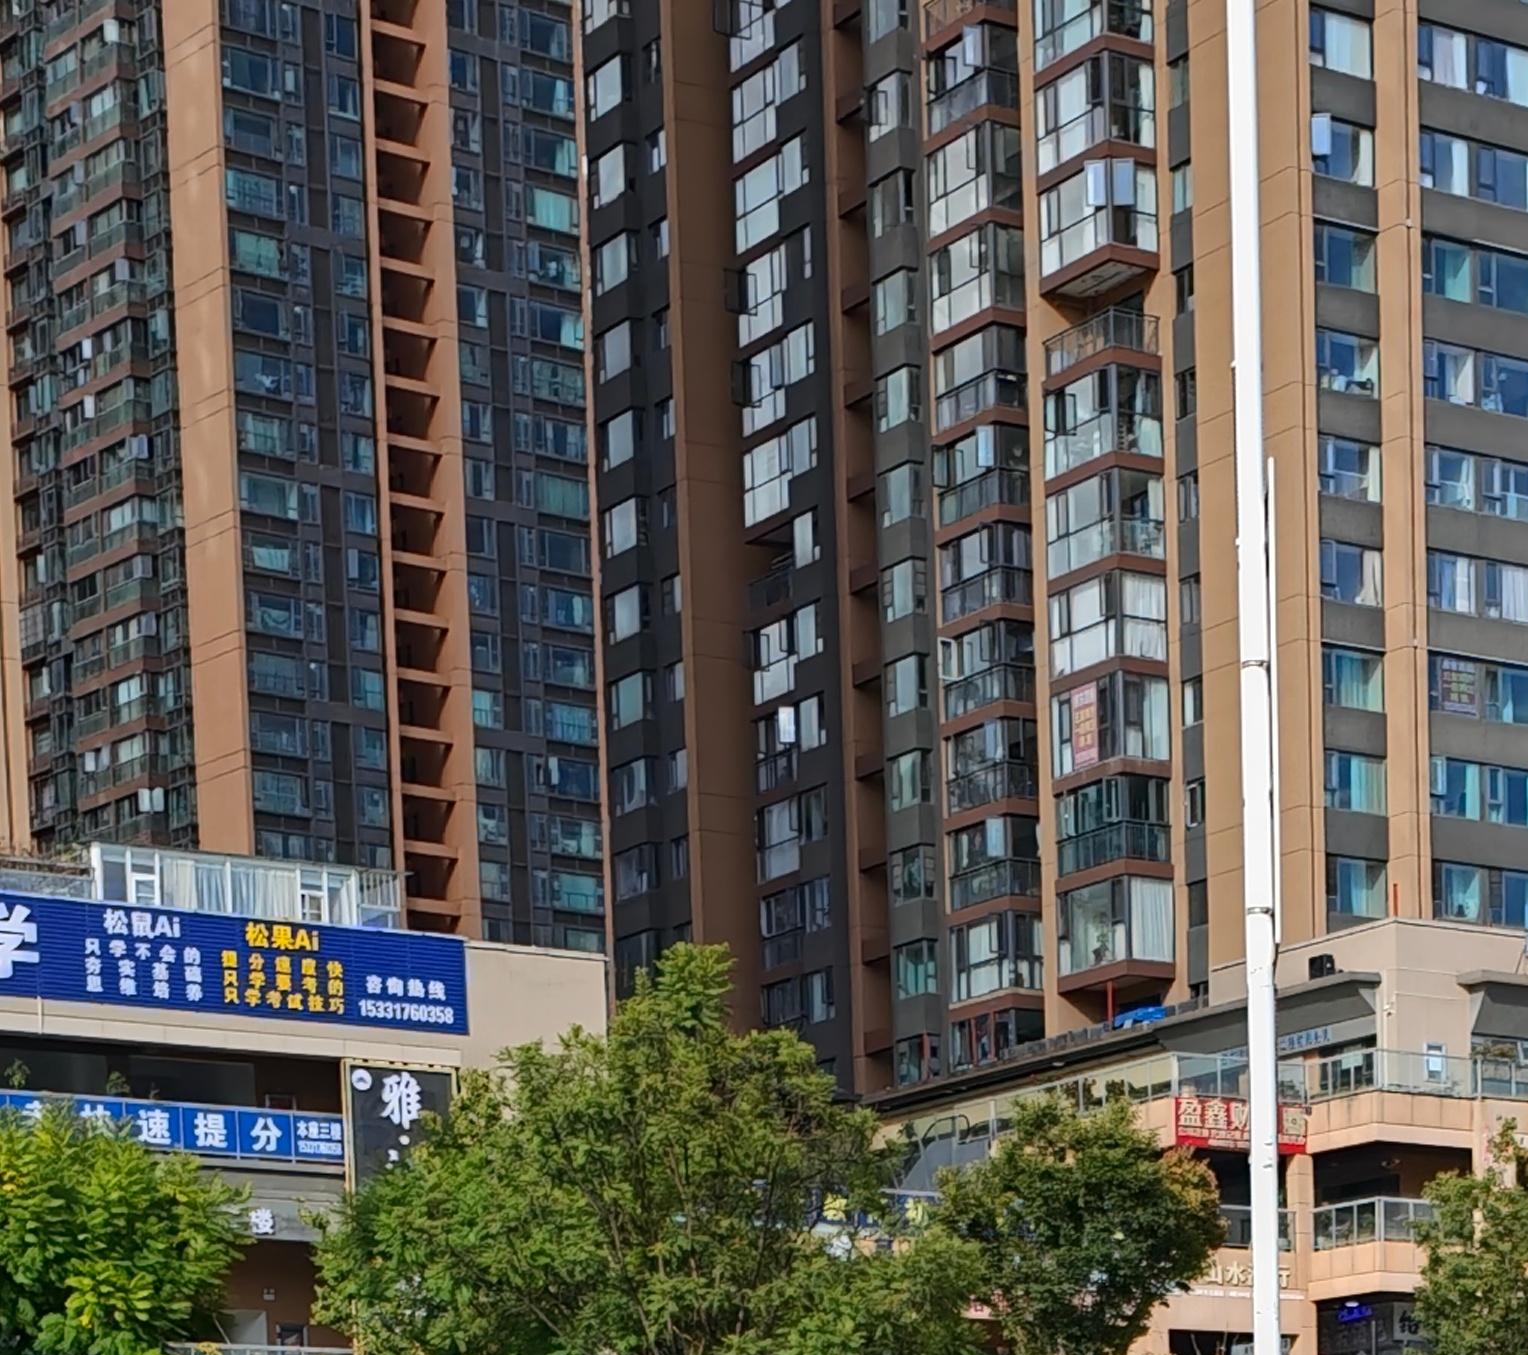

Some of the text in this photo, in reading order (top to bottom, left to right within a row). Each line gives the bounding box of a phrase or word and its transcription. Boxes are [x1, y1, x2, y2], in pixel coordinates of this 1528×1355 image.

[245, 921, 320, 952] 松果Ai
[365, 974, 447, 1001] 咨询热线
